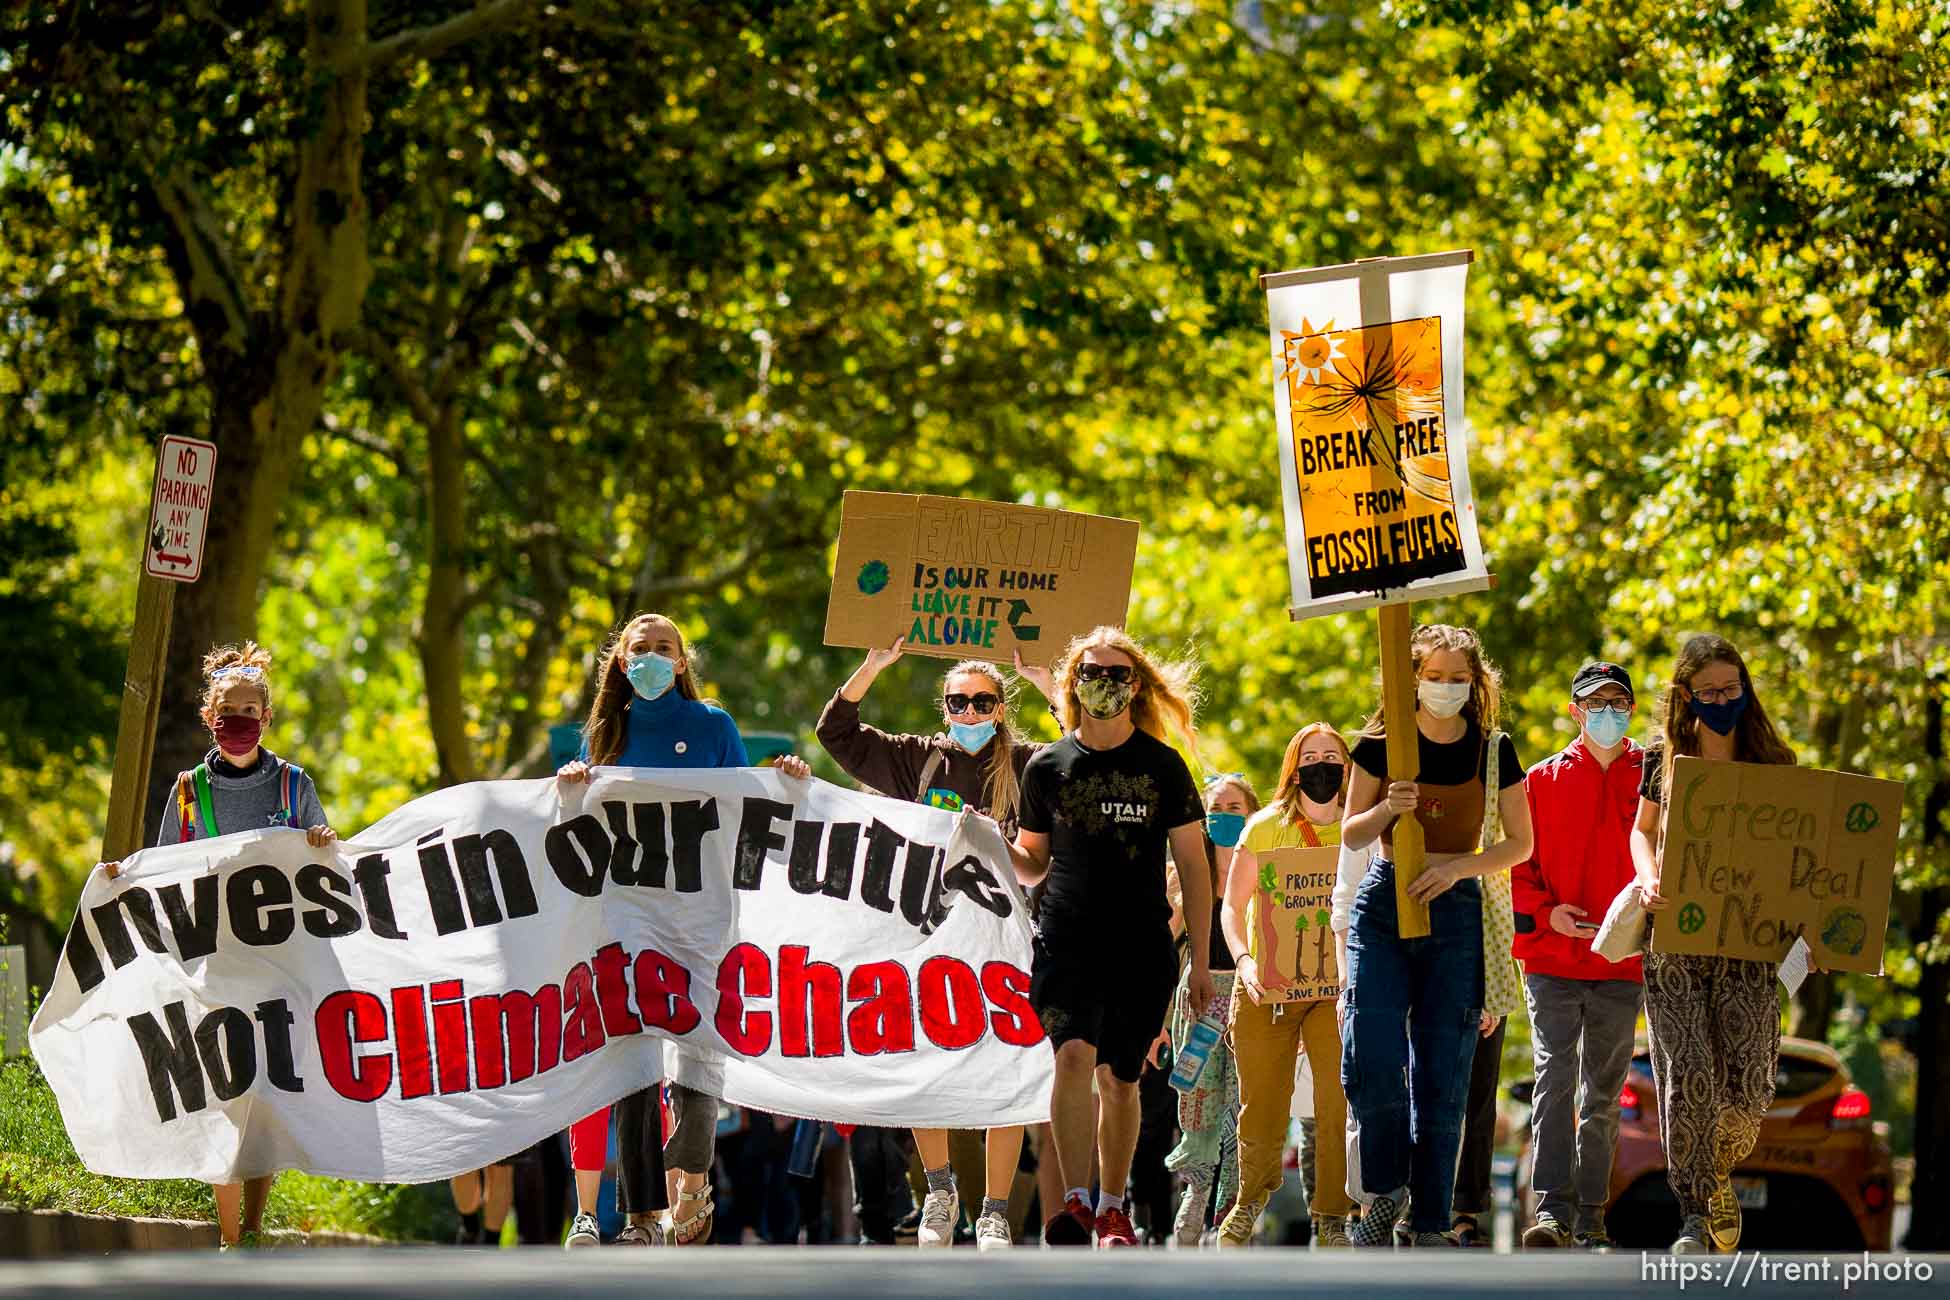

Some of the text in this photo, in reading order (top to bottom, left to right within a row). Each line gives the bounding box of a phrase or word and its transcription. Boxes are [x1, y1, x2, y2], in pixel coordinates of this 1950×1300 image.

[1301, 416, 1440, 475] BREAK FREE
[176, 449, 198, 477] NO
[160, 478, 207, 510] PARKING
[1354, 487, 1407, 516] FROM
[169, 509, 191, 528] ANY
[166, 528, 191, 549] TIME
[912, 505, 1088, 571] EARTH
[1308, 511, 1459, 578] FOSSIL FUELS
[913, 563, 1058, 591] IS OUR HOME
[911, 588, 1002, 617] LEAVE IT
[908, 616, 1001, 648] ALONE
[1101, 802, 1147, 816] UTAH
[1682, 772, 1816, 841] Green
[1679, 841, 1865, 900] New Deal
[65, 797, 1013, 994] Invest in our Futue
[1718, 893, 1810, 948] Now
[1286, 987, 1313, 1000] SAVE
[127, 941, 1051, 1123] Not Climate Chaos
